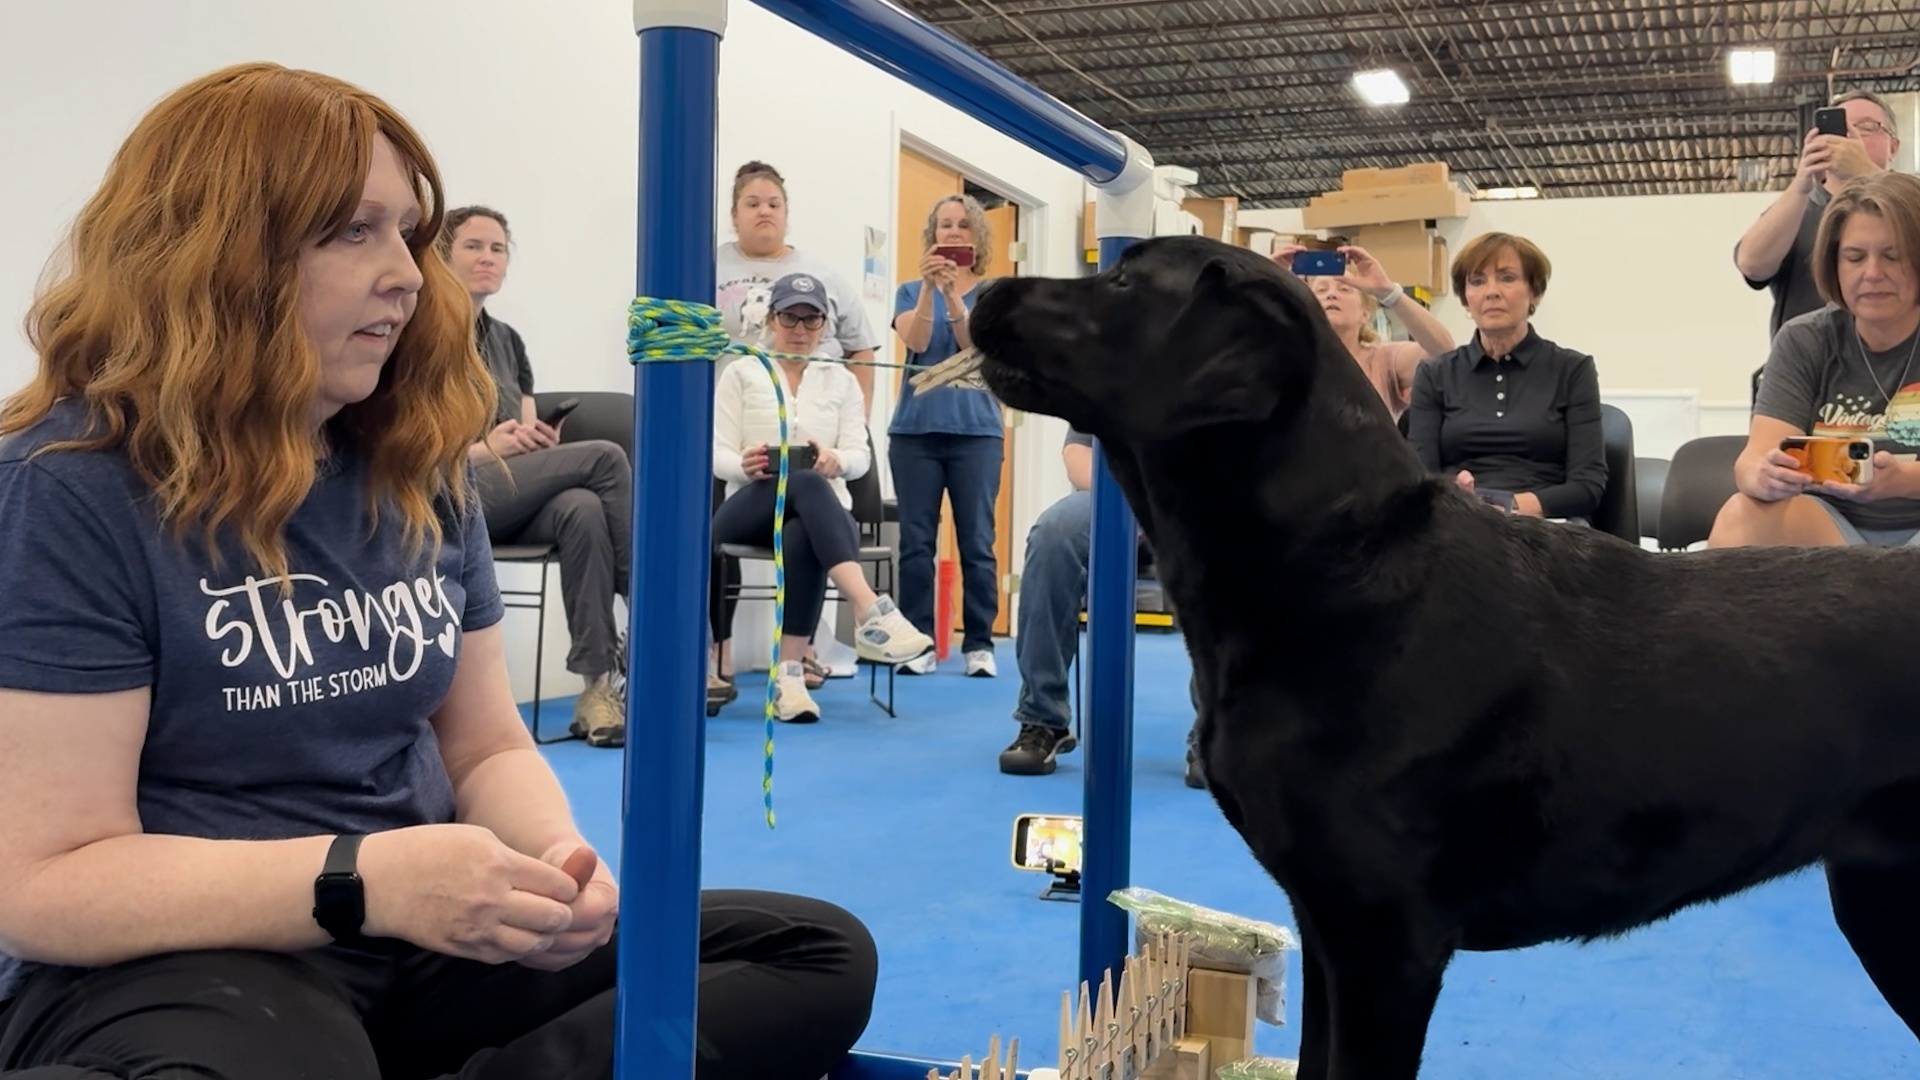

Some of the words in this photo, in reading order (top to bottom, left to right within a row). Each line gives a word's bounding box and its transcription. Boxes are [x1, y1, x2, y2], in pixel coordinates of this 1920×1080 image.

[200, 568, 460, 681] stronger
[222, 685, 281, 712] THAN
[287, 676, 324, 706] THE
[329, 663, 388, 697] STORM
